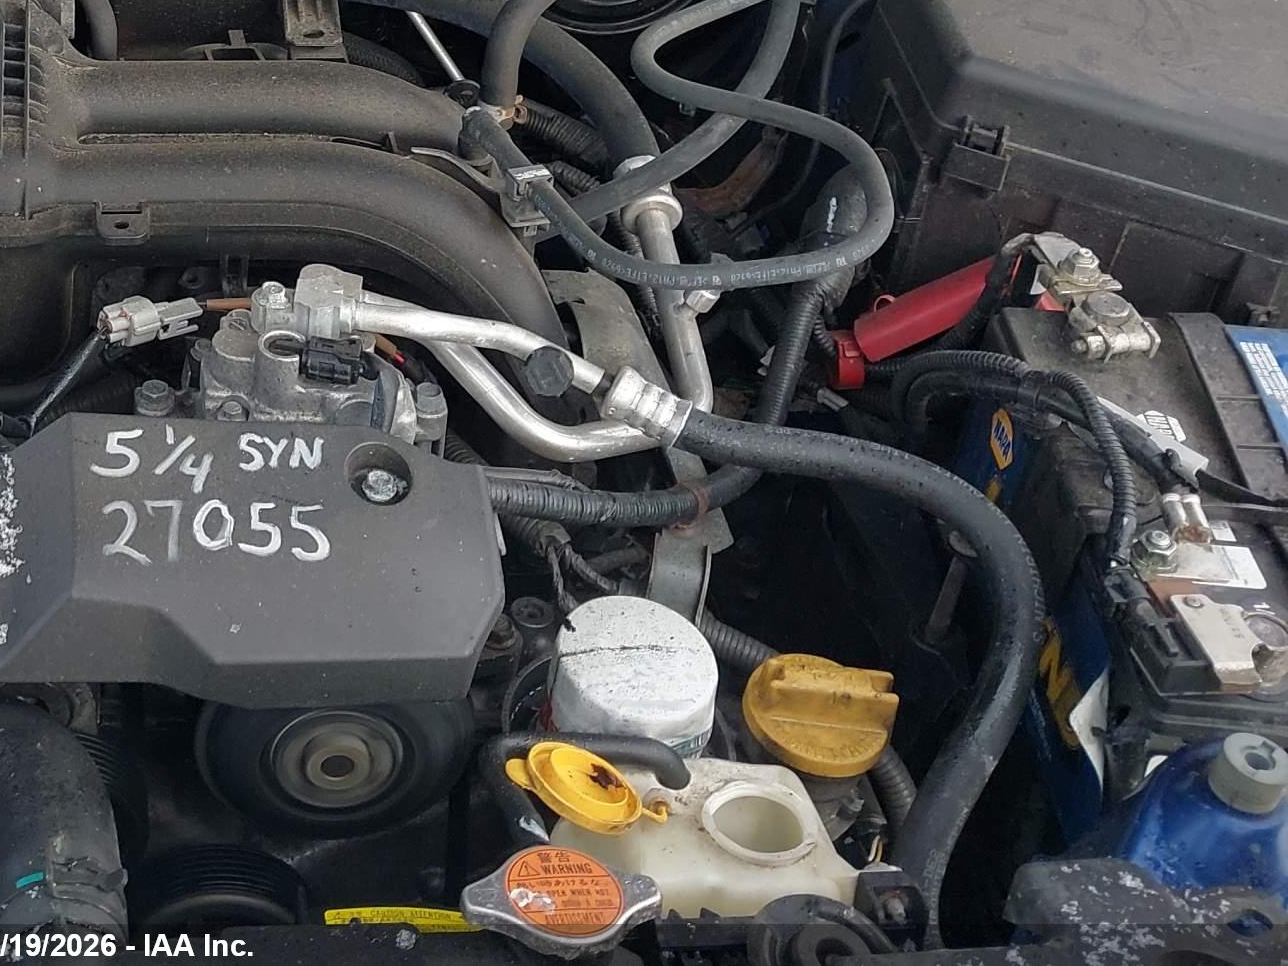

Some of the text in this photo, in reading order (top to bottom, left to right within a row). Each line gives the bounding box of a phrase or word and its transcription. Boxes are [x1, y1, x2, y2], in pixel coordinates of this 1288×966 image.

[89, 428, 144, 478] 5
[238, 432, 325, 472] SYN
[991, 419, 1012, 462] NAPA
[102, 498, 331, 566] 27055
[540, 862, 593, 875] WARNING
